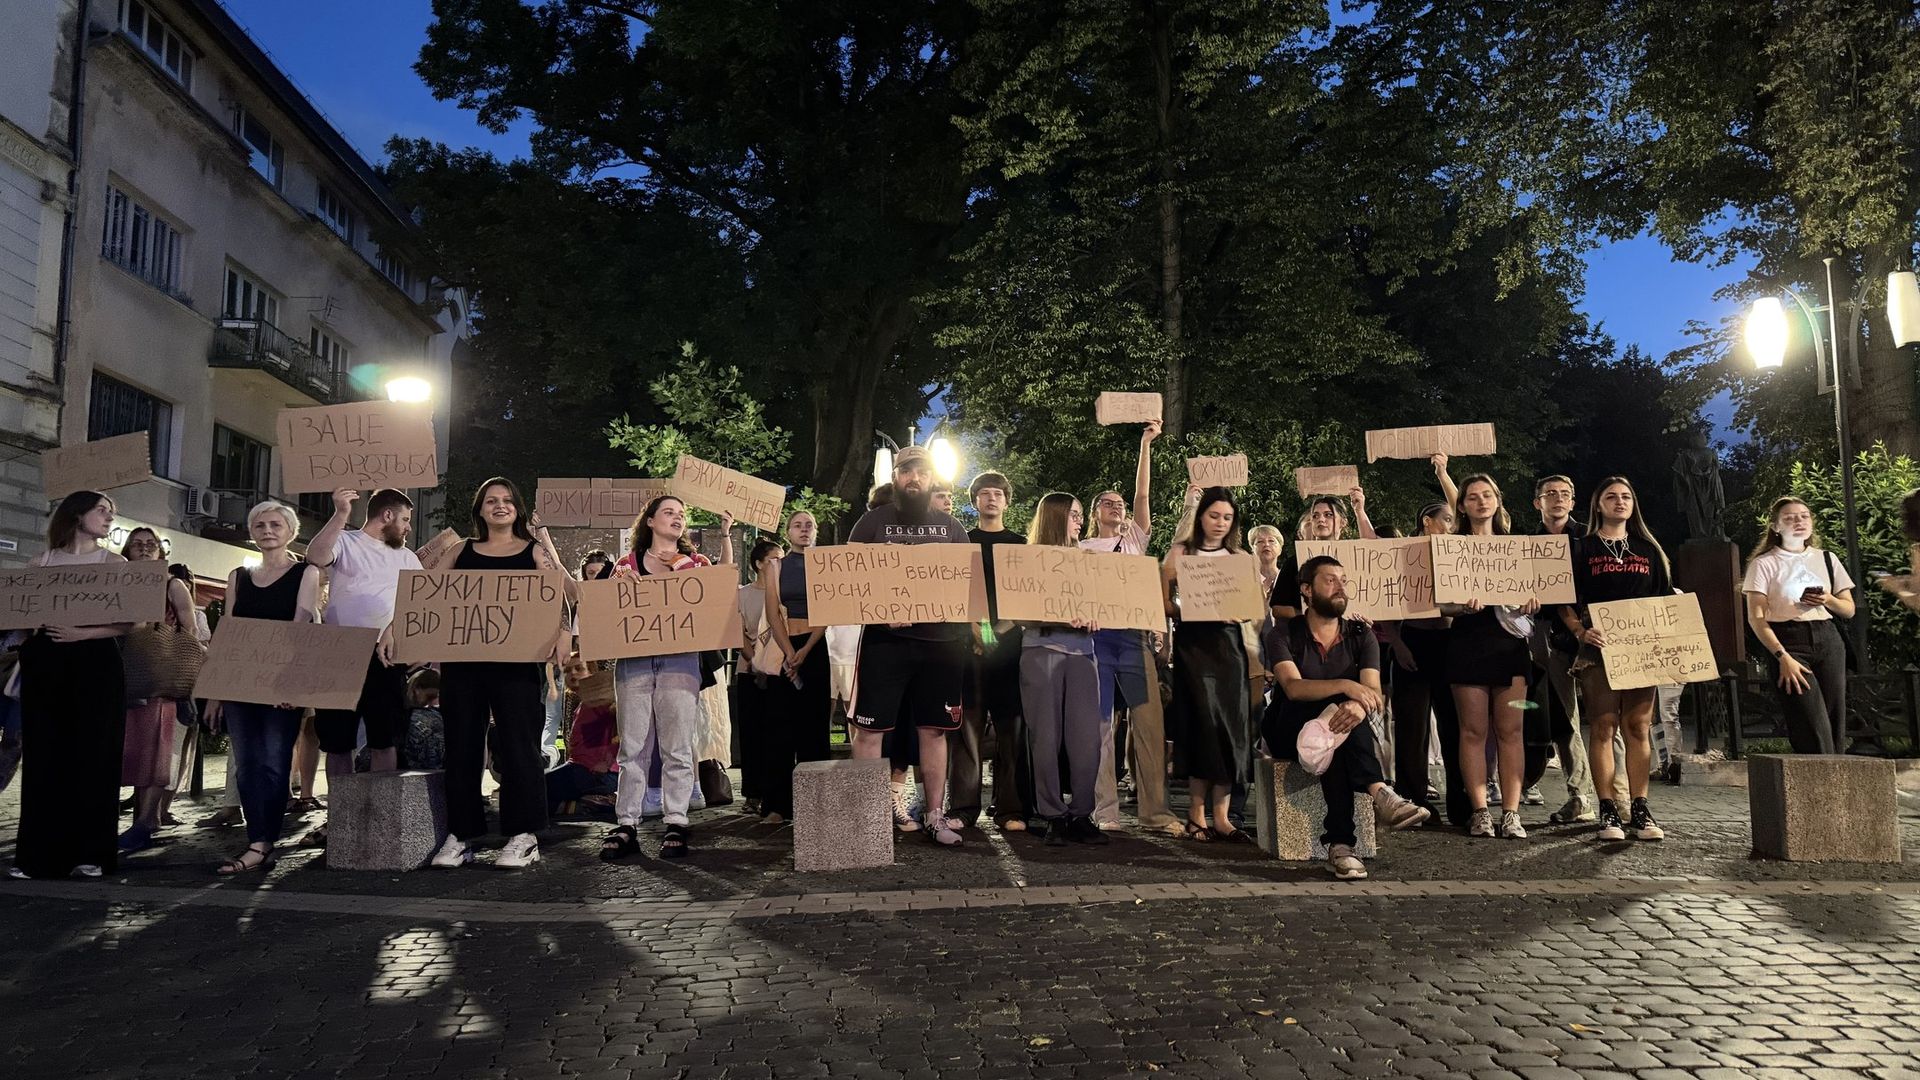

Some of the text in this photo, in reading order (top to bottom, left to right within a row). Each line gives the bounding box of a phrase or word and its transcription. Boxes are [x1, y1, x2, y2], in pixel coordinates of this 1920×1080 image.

[302, 414, 338, 446] ЗА
[344, 413, 385, 447] ЦЕ
[681, 456, 724, 490] РУКИ
[543, 490, 592, 516] РУКИ
[1354, 545, 1427, 574] ПРОТИ
[1436, 537, 1567, 559] НЕЗАЛЕЖНЕ НАБУ
[813, 547, 973, 580] УКРАЇНУ ВБИВАЄ
[1456, 557, 1518, 573] ГАРАНТІЯ
[46, 569, 98, 587] ЯКИЙ
[411, 574, 556, 602] РУКИ ГЕТЬ
[813, 582, 872, 600] РУСНЯ
[1002, 577, 1084, 597] ШЛЯХ ДО
[10, 593, 41, 617] ЦЕ
[617, 576, 704, 609] ВЕТО
[447, 604, 515, 645] НАБУ
[860, 601, 966, 622] КОРУПЦІЯ
[1043, 597, 1157, 627] ДИКТАТУРИ
[1653, 604, 1679, 627] НЕ
[617, 611, 695, 644] 12414
[1611, 654, 1630, 668] БО
